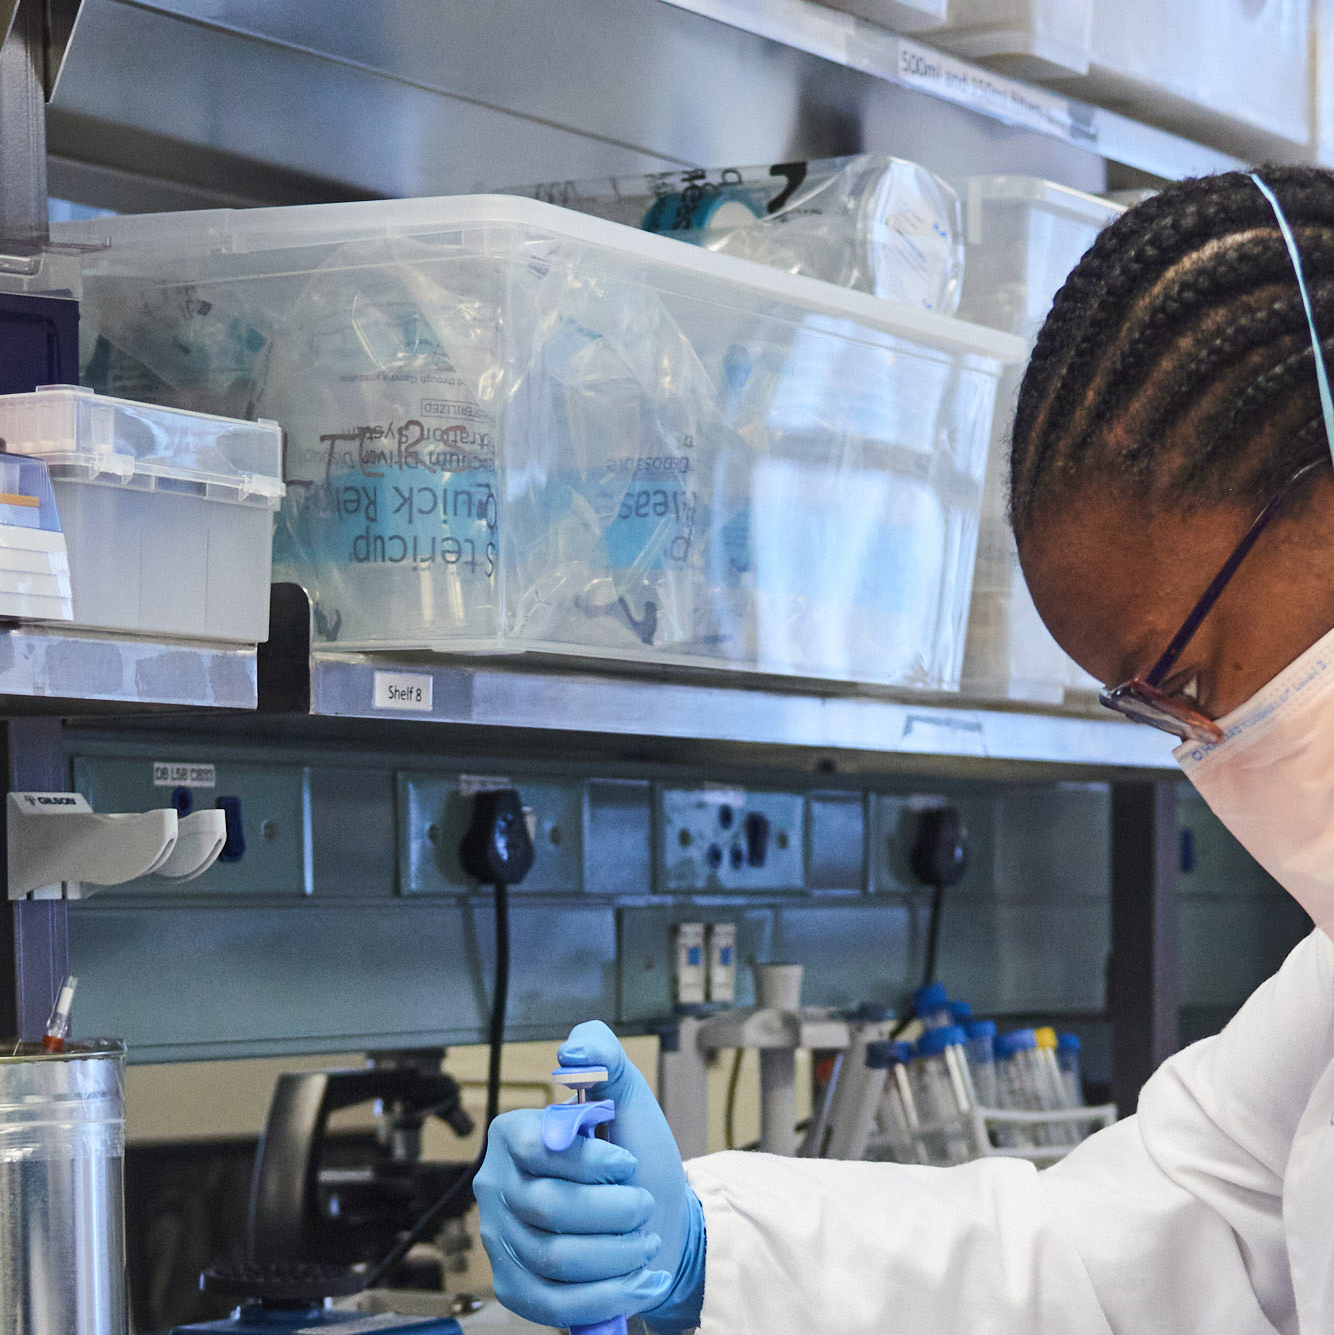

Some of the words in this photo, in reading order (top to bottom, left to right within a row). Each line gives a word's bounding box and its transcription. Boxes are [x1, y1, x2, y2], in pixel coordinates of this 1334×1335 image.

[388, 685, 414, 701] Shelf
[415, 687, 423, 702] 8
[155, 766, 169, 781] DB
[38, 796, 76, 806] GILSON
